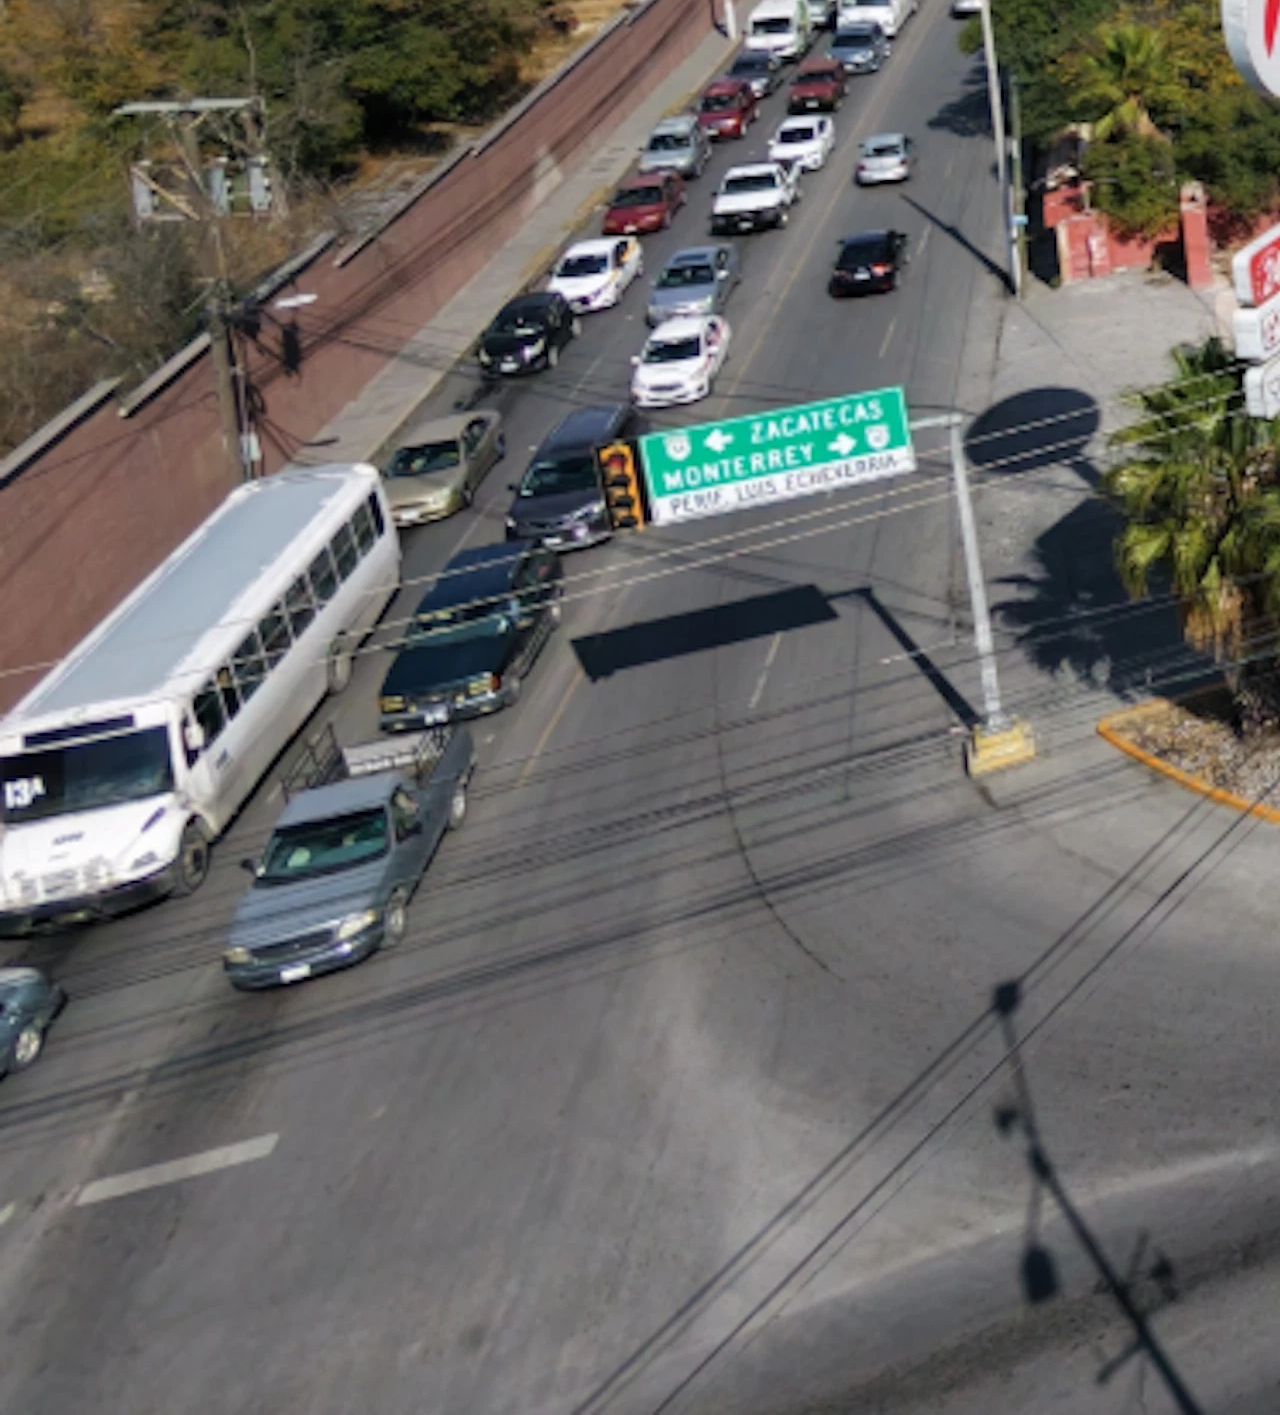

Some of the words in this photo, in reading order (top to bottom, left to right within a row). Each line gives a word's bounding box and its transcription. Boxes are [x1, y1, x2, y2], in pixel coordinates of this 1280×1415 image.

[749, 397, 885, 446] ZACATECAS
[662, 442, 815, 492] MONTERREY
[736, 476, 777, 502] LUIS
